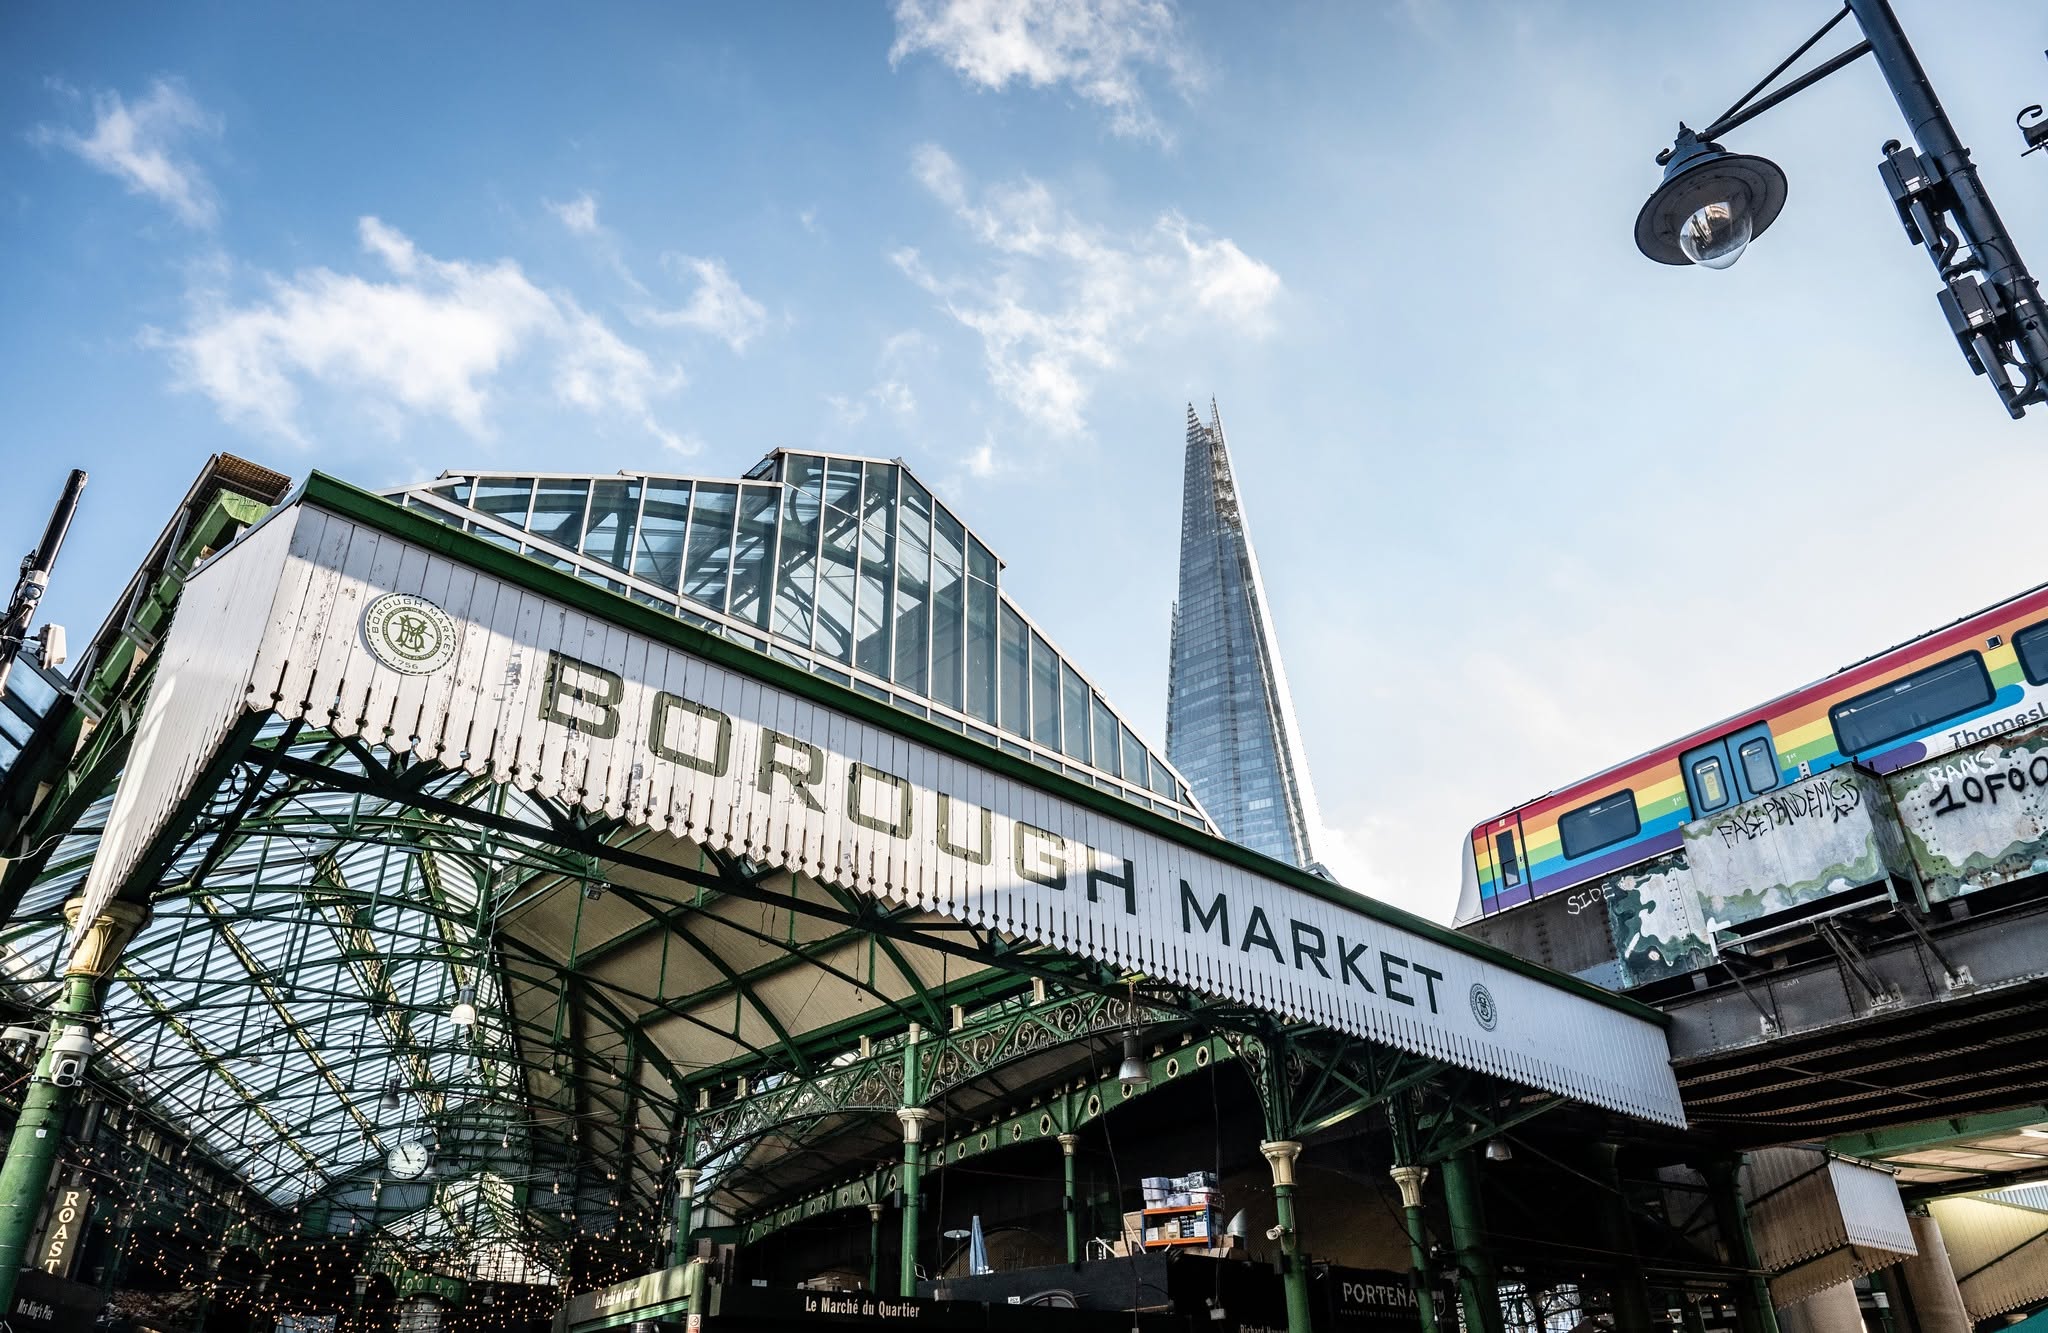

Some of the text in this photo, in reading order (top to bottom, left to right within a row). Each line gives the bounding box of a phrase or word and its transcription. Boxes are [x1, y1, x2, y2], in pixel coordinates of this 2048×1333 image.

[372, 598, 423, 634] BOROUGH
[428, 608, 451, 657] MARKET
[392, 656, 419, 669] 1756
[538, 649, 1443, 1014] BOROUGH MARKET
[1717, 803, 1768, 849] FAKE
[1567, 882, 1615, 915] SIDE
[45, 1191, 80, 1275] ROAST
[17, 1298, 28, 1314] Mrs
[805, 1295, 920, 1319] Le Marché du Quartier
[1342, 1282, 1419, 1307] PORTEÑA
